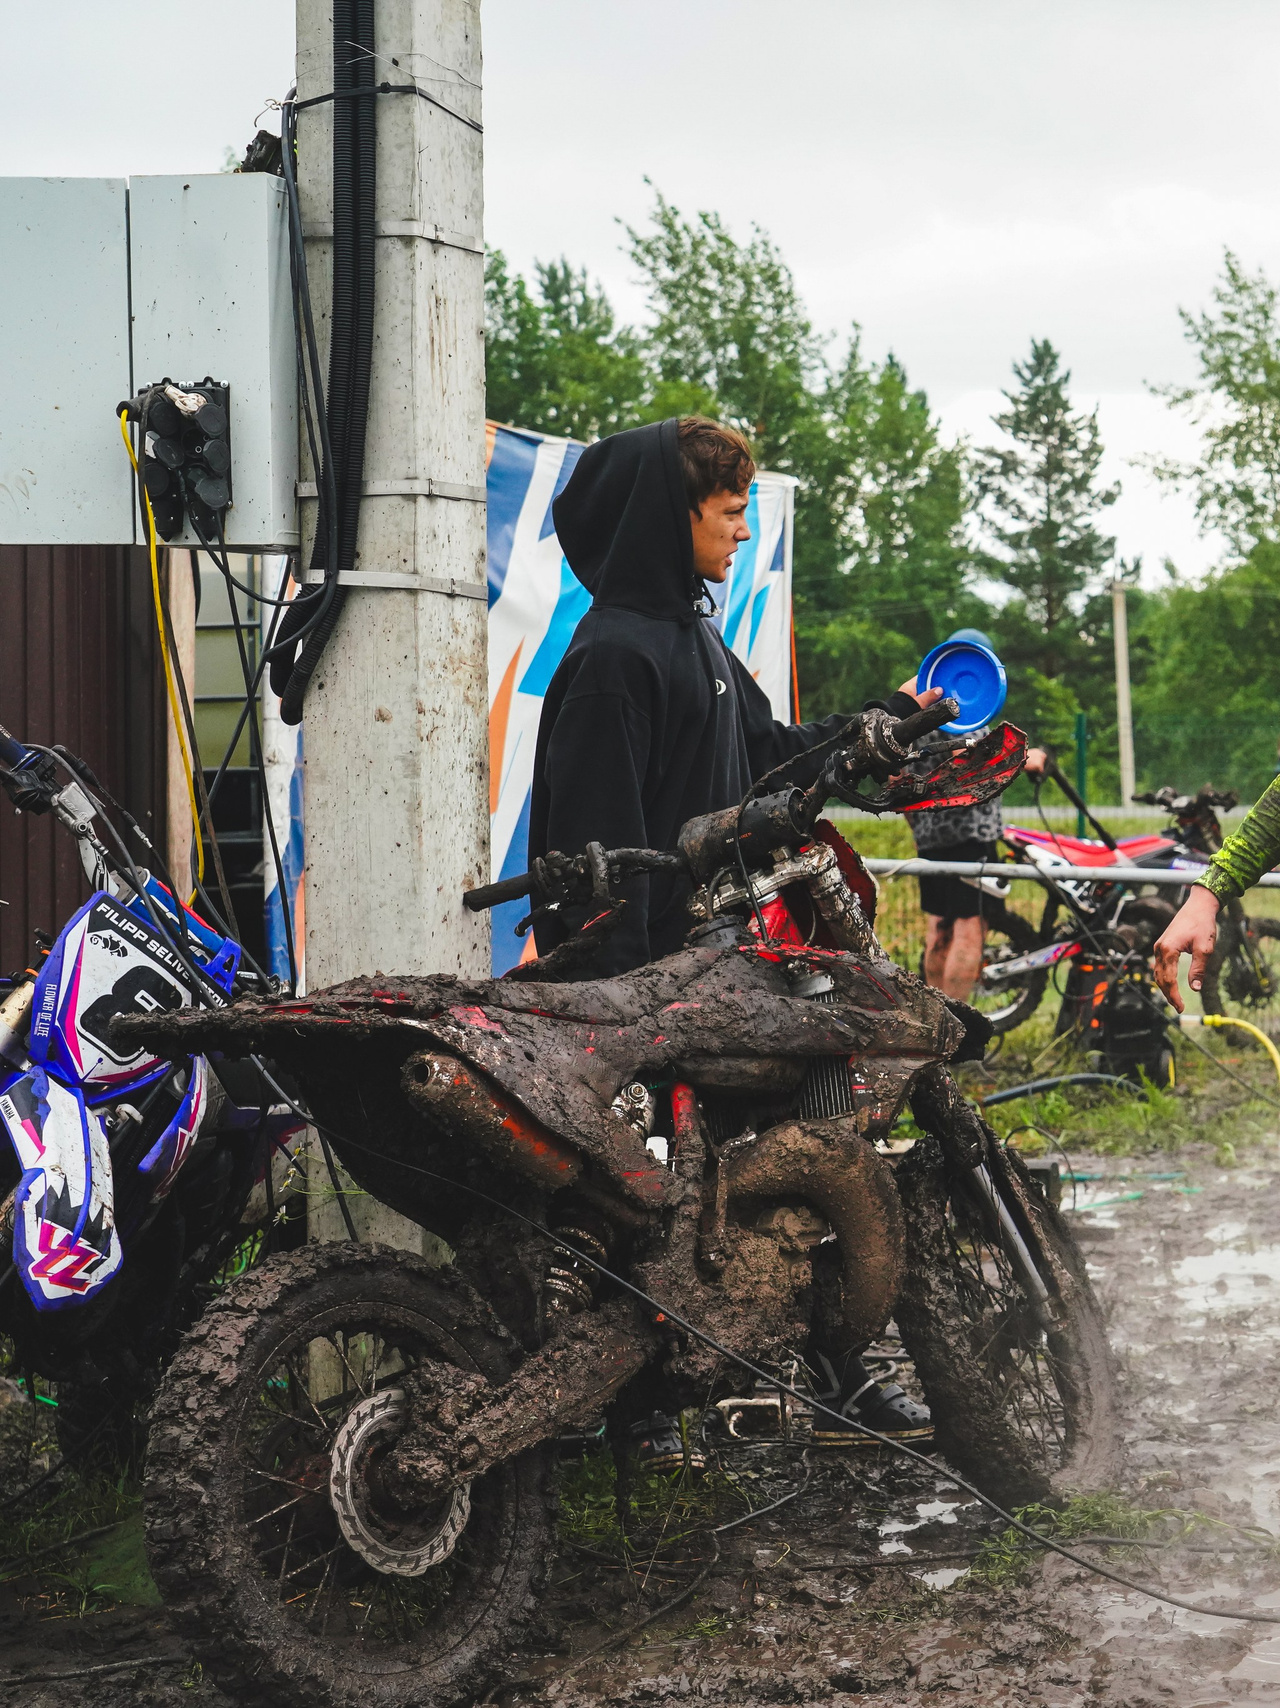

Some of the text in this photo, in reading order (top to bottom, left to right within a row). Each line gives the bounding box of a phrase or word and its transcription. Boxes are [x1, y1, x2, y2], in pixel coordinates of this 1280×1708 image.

[96, 903, 149, 942] FILIPP
[42, 984, 57, 1011] FLOWER
[40, 1012, 52, 1021] OF
[36, 1022, 50, 1037] LIFE
[0, 1098, 15, 1120] YAMAHA
